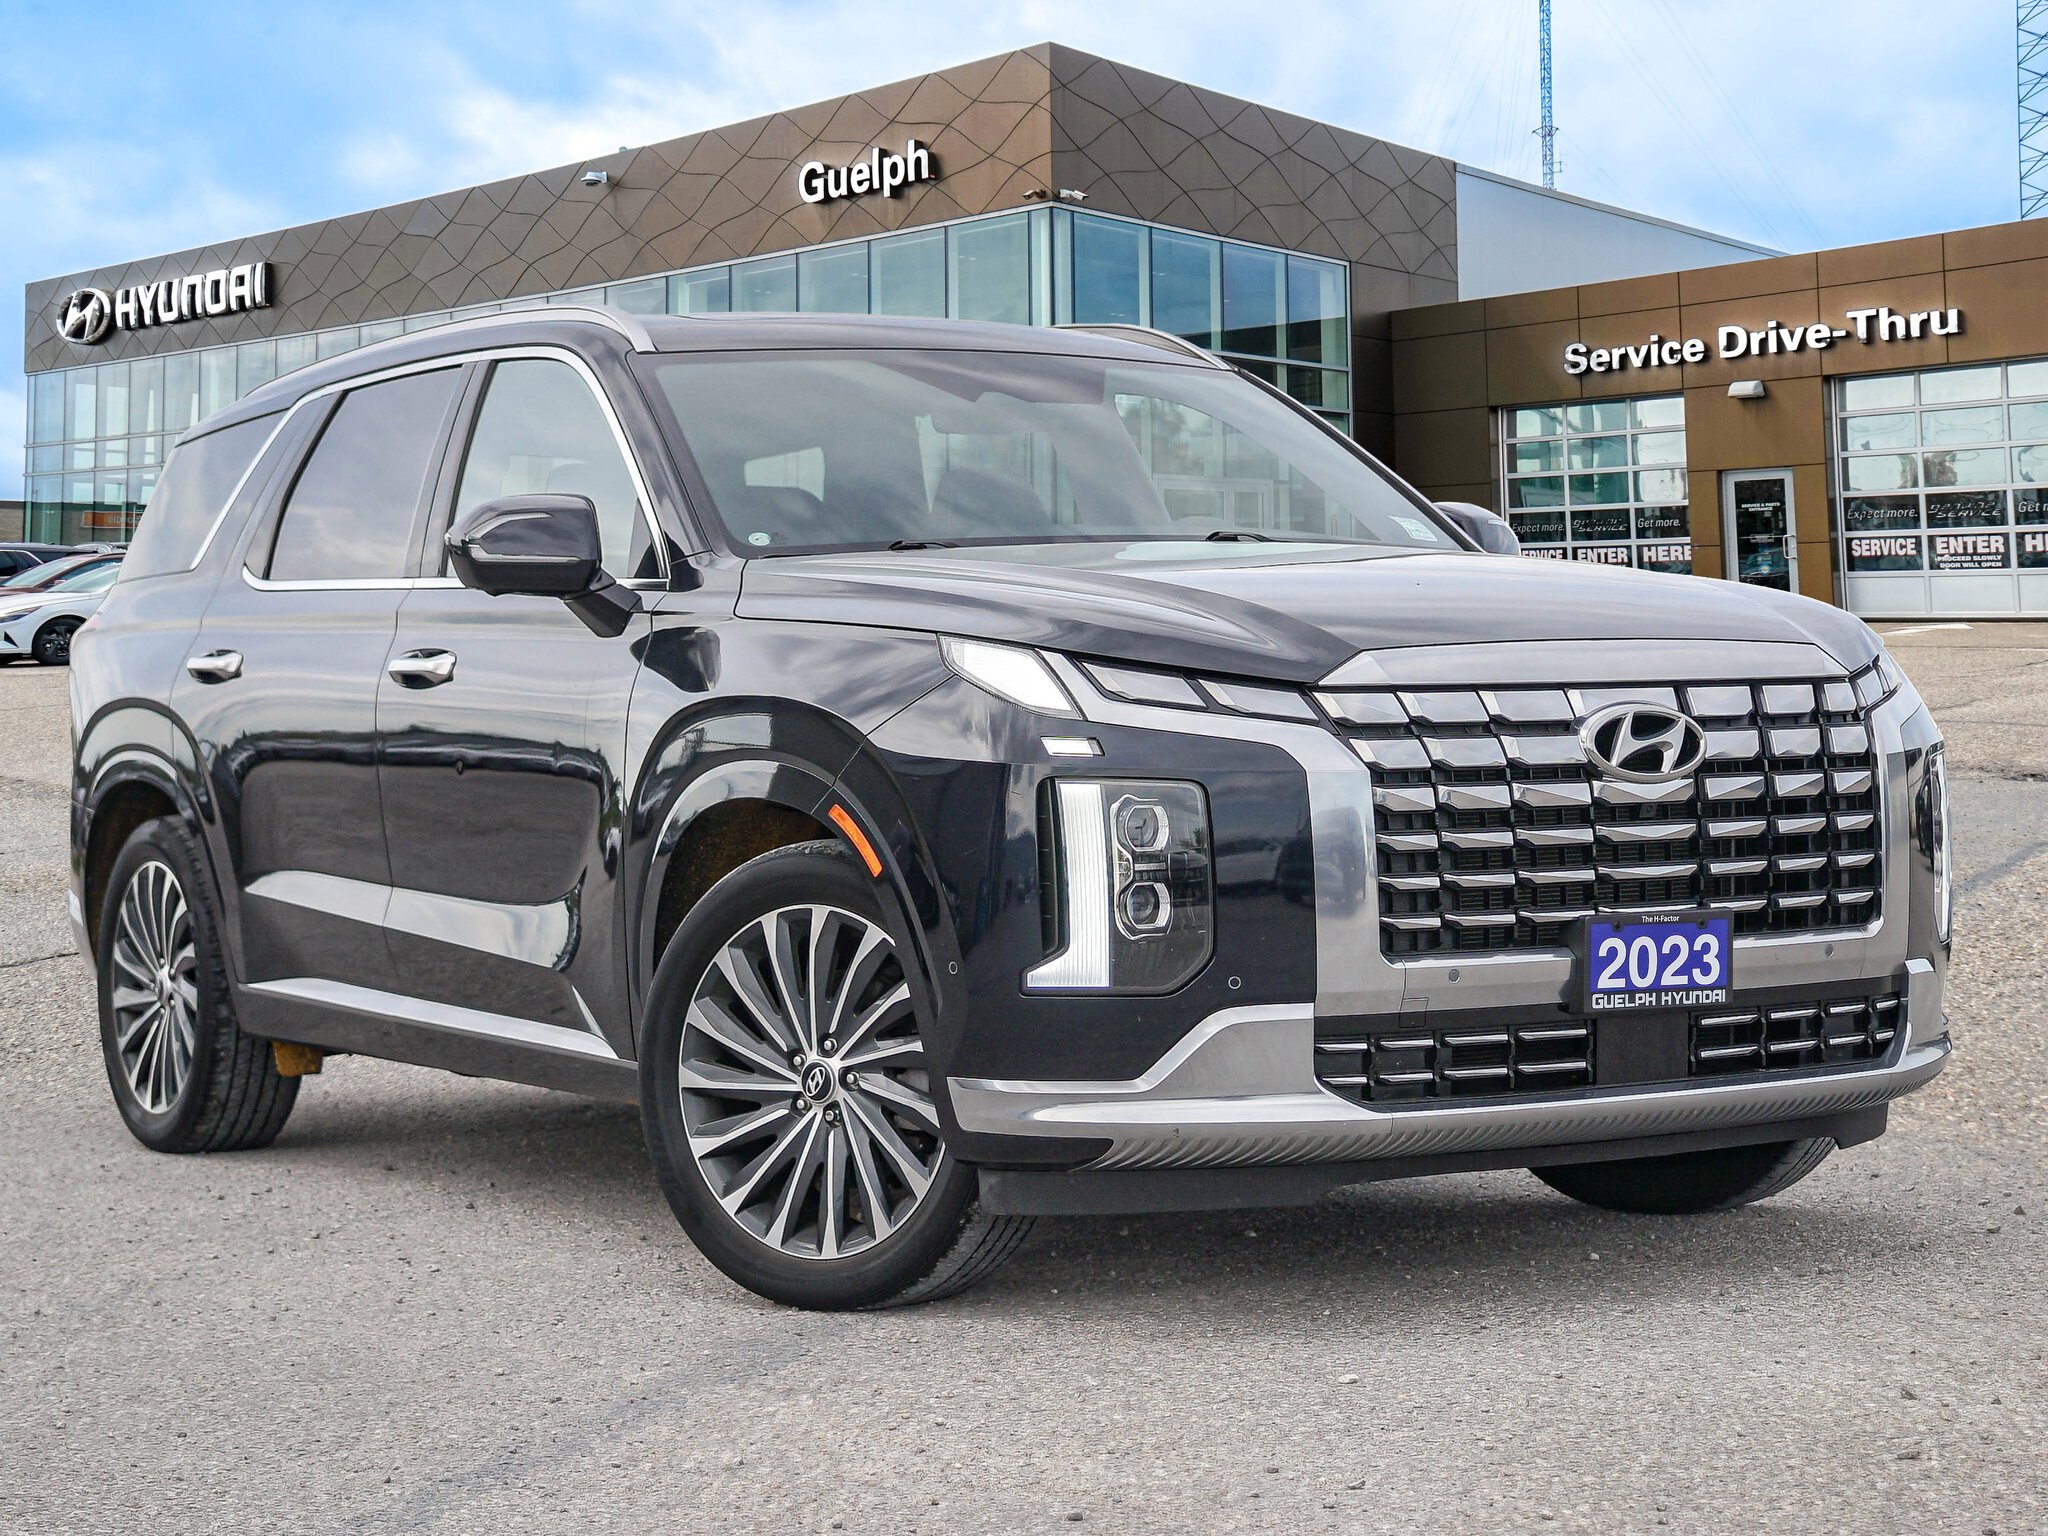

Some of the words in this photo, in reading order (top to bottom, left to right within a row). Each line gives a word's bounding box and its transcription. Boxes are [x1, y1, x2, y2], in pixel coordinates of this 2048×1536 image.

[798, 138, 930, 203] Guelph
[115, 262, 269, 331] HYUNDAI
[1563, 333, 1706, 376] Service
[1718, 306, 1962, 359] Drive-Thru
[1848, 507, 1884, 520] Expect
[1886, 508, 1918, 518] more.
[1936, 508, 2003, 518] SERVICE
[2018, 501, 2041, 513] Get
[1512, 523, 1540, 534] Expect
[1637, 518, 1654, 528] Get
[1655, 518, 1681, 527] more.
[1642, 545, 1692, 563] HERE
[1851, 537, 1917, 557] SERVICE
[1935, 535, 2005, 555] ENTER
[1577, 547, 1629, 564] ENTER
[1641, 915, 1654, 923] The
[1655, 914, 1680, 922] H-Factor
[1597, 933, 1721, 989] 2023
[1591, 992, 1656, 1009] GUELPH
[1661, 989, 1726, 1006] HYUNDAI
